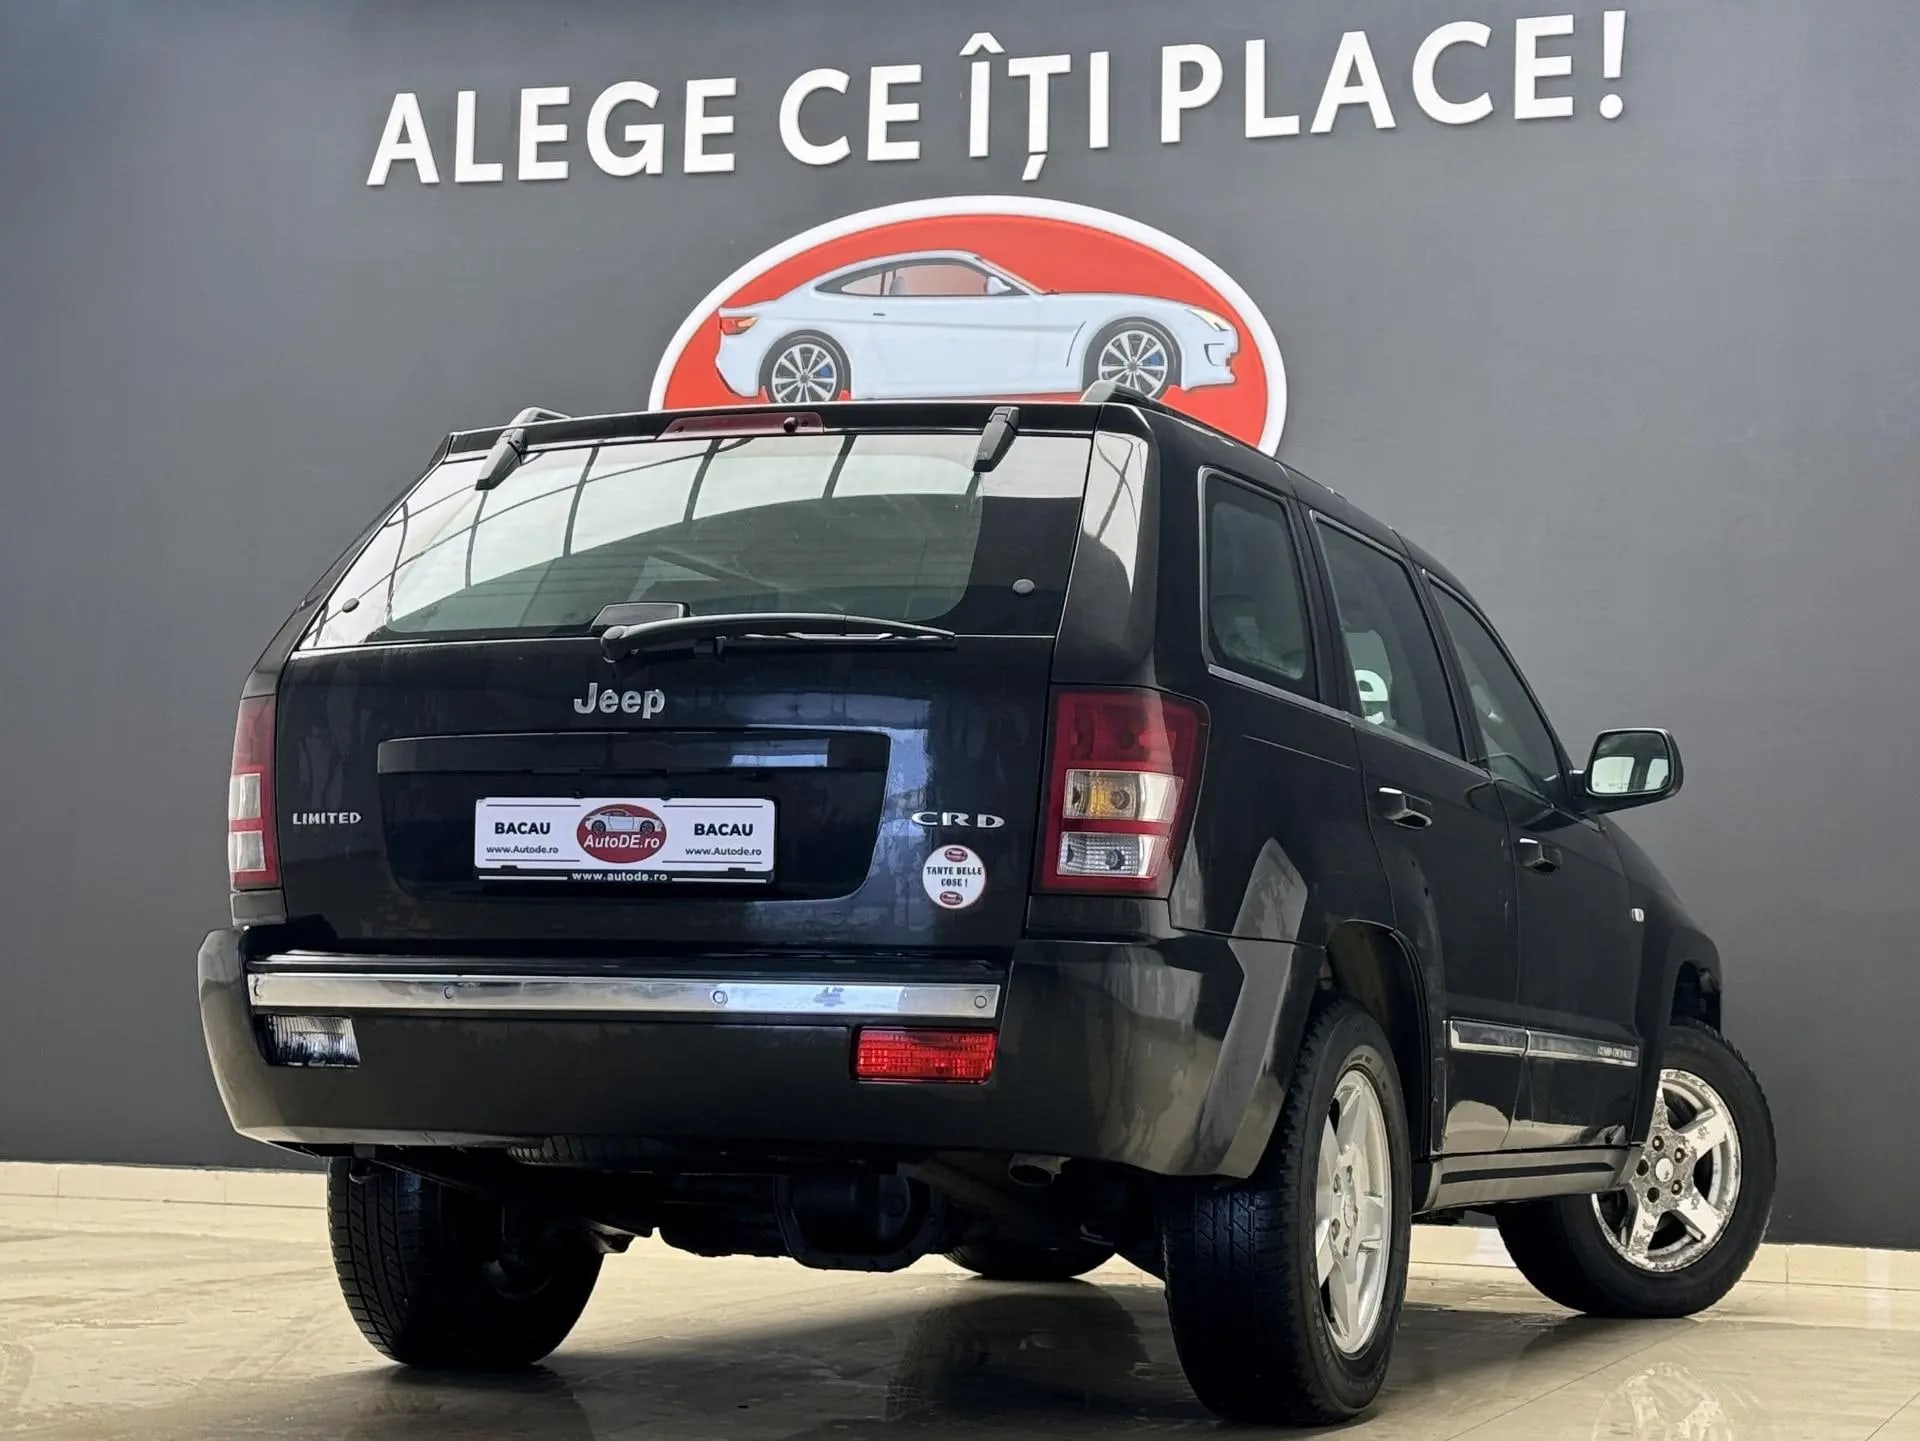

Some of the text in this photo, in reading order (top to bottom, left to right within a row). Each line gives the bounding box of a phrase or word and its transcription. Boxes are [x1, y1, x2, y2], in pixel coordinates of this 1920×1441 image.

[366, 10, 1627, 186] ALEGE CE ÎȚI PLACE!
[573, 682, 665, 719] Jeep
[292, 812, 362, 825] LIMITED
[911, 811, 1005, 828] CRD
[494, 821, 551, 835] BACAU
[693, 823, 754, 837] BACAU
[583, 834, 660, 848] AutoDE.ro
[486, 844, 559, 854] www.Autode.ro
[685, 846, 762, 856] www.Autode.ro
[571, 872, 668, 882] www.autode.ro
[926, 867, 982, 875] TANTE BELLE
